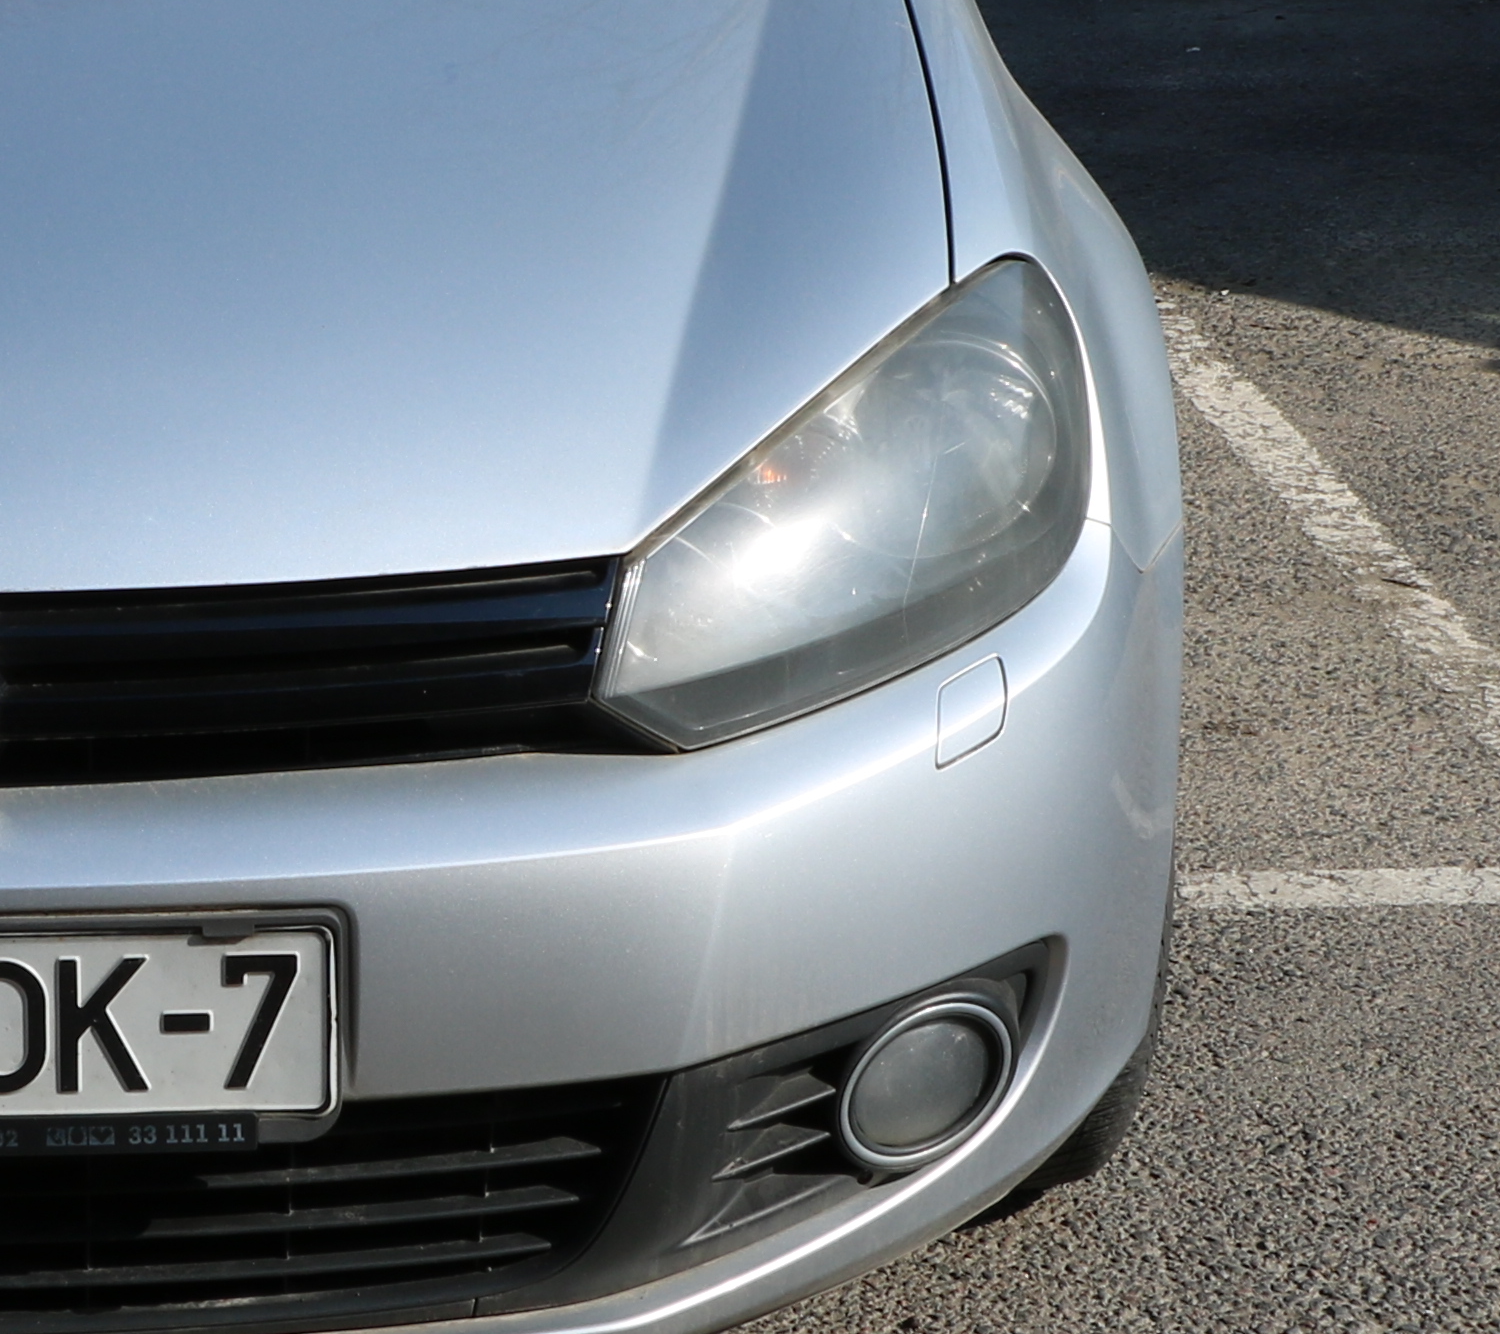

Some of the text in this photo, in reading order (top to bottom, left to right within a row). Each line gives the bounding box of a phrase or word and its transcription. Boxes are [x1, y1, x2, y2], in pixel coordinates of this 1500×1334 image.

[127, 1123, 245, 1145] 33 111 11
